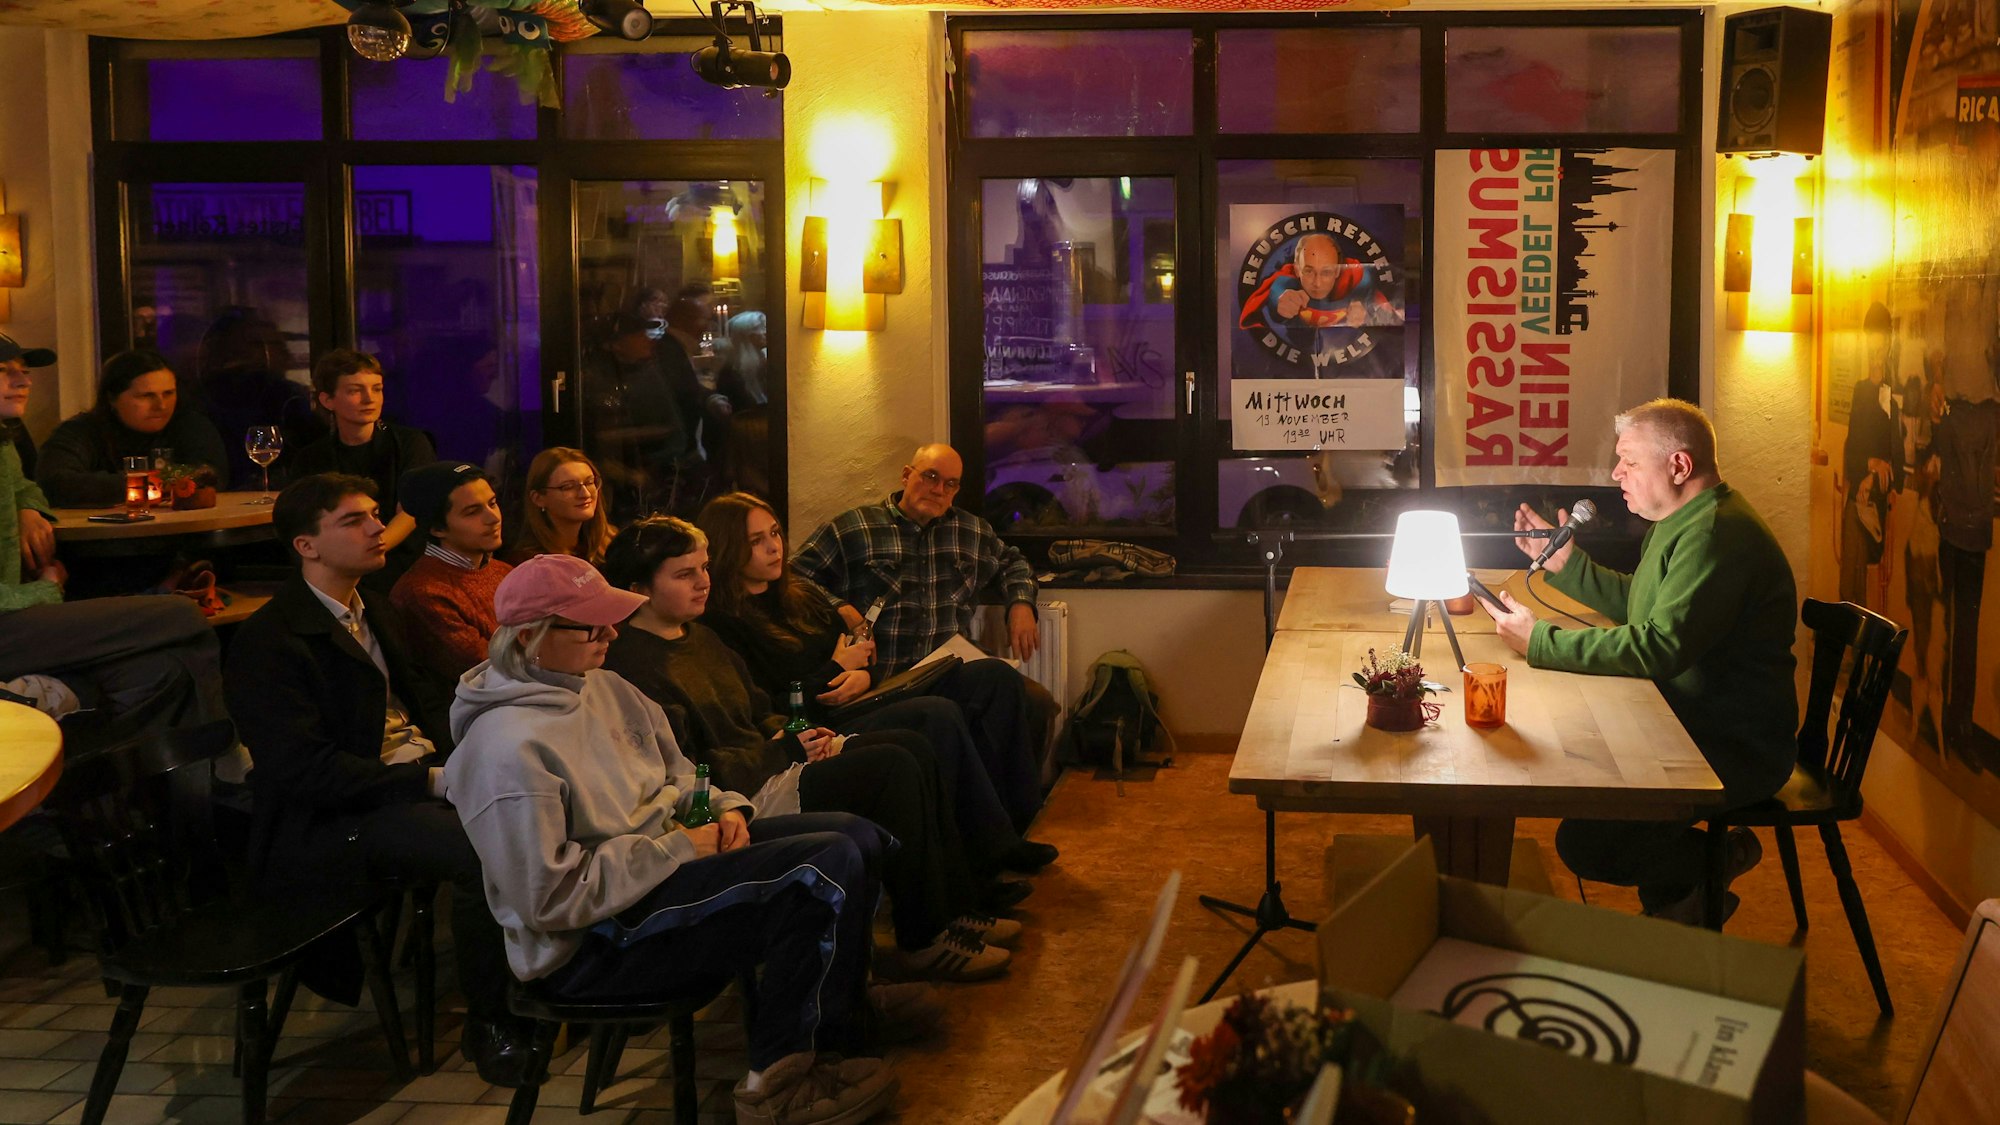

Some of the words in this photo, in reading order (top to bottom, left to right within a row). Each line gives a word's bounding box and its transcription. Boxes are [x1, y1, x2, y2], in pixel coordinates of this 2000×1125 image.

[1959, 95, 1999, 122] RICA
[1242, 216, 1316, 286] REUSCH
[1327, 217, 1394, 284] RETTET
[1262, 332, 1301, 363] DIE
[1311, 332, 1372, 367] WELT
[1277, 412, 1350, 426] NOVEMBER
[1319, 428, 1346, 445] UHR
